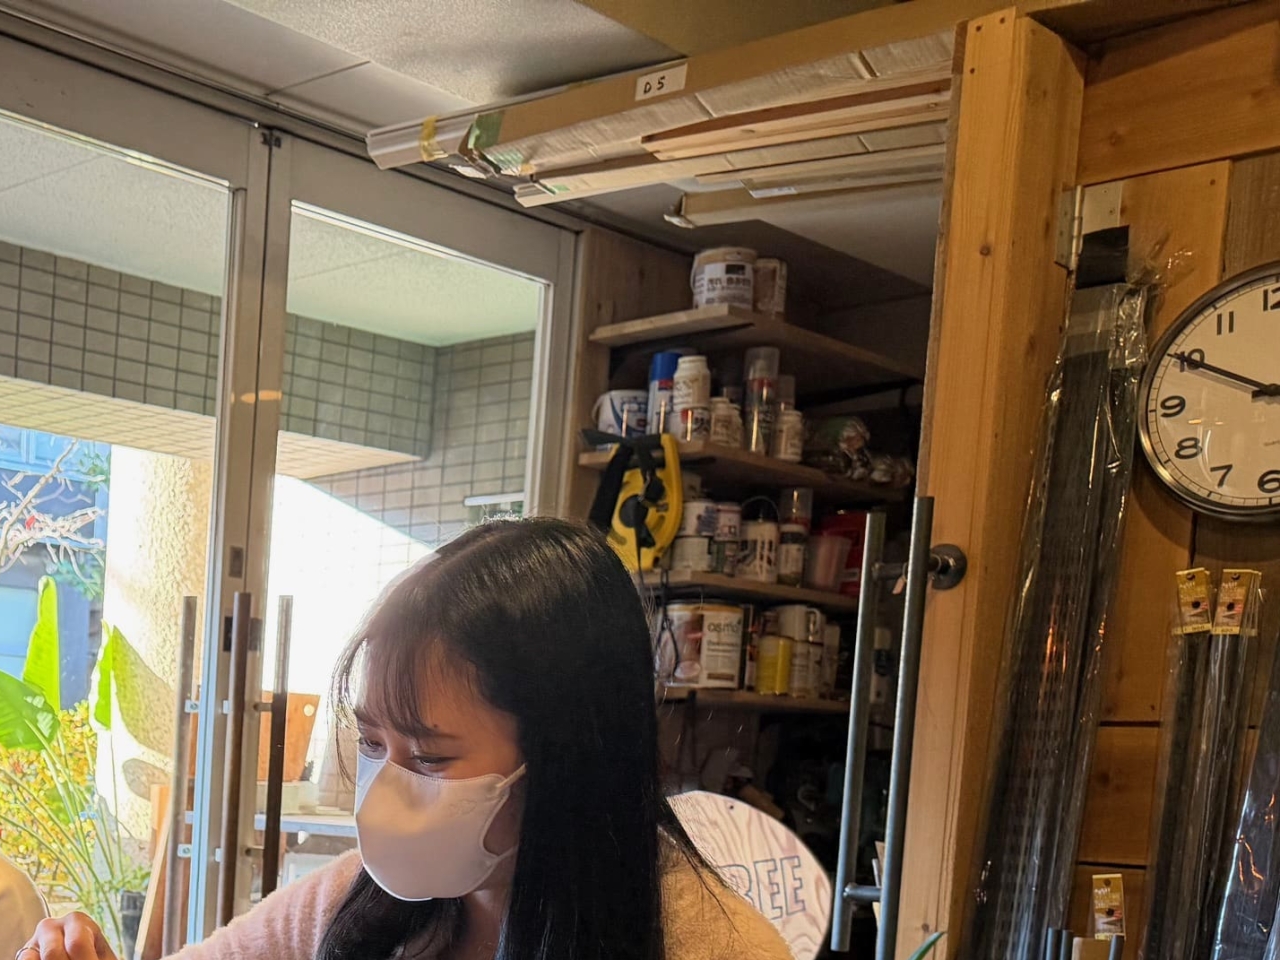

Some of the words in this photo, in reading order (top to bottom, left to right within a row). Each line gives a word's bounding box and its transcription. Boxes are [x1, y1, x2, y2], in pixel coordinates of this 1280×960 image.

[656, 75, 666, 91] 5
[1216, 310, 1235, 336] 11
[1178, 348, 1206, 373] 10
[1160, 395, 1186, 418] 9
[1174, 436, 1202, 460] 8
[1209, 463, 1234, 489] 7
[1257, 469, 1280, 494] 6
